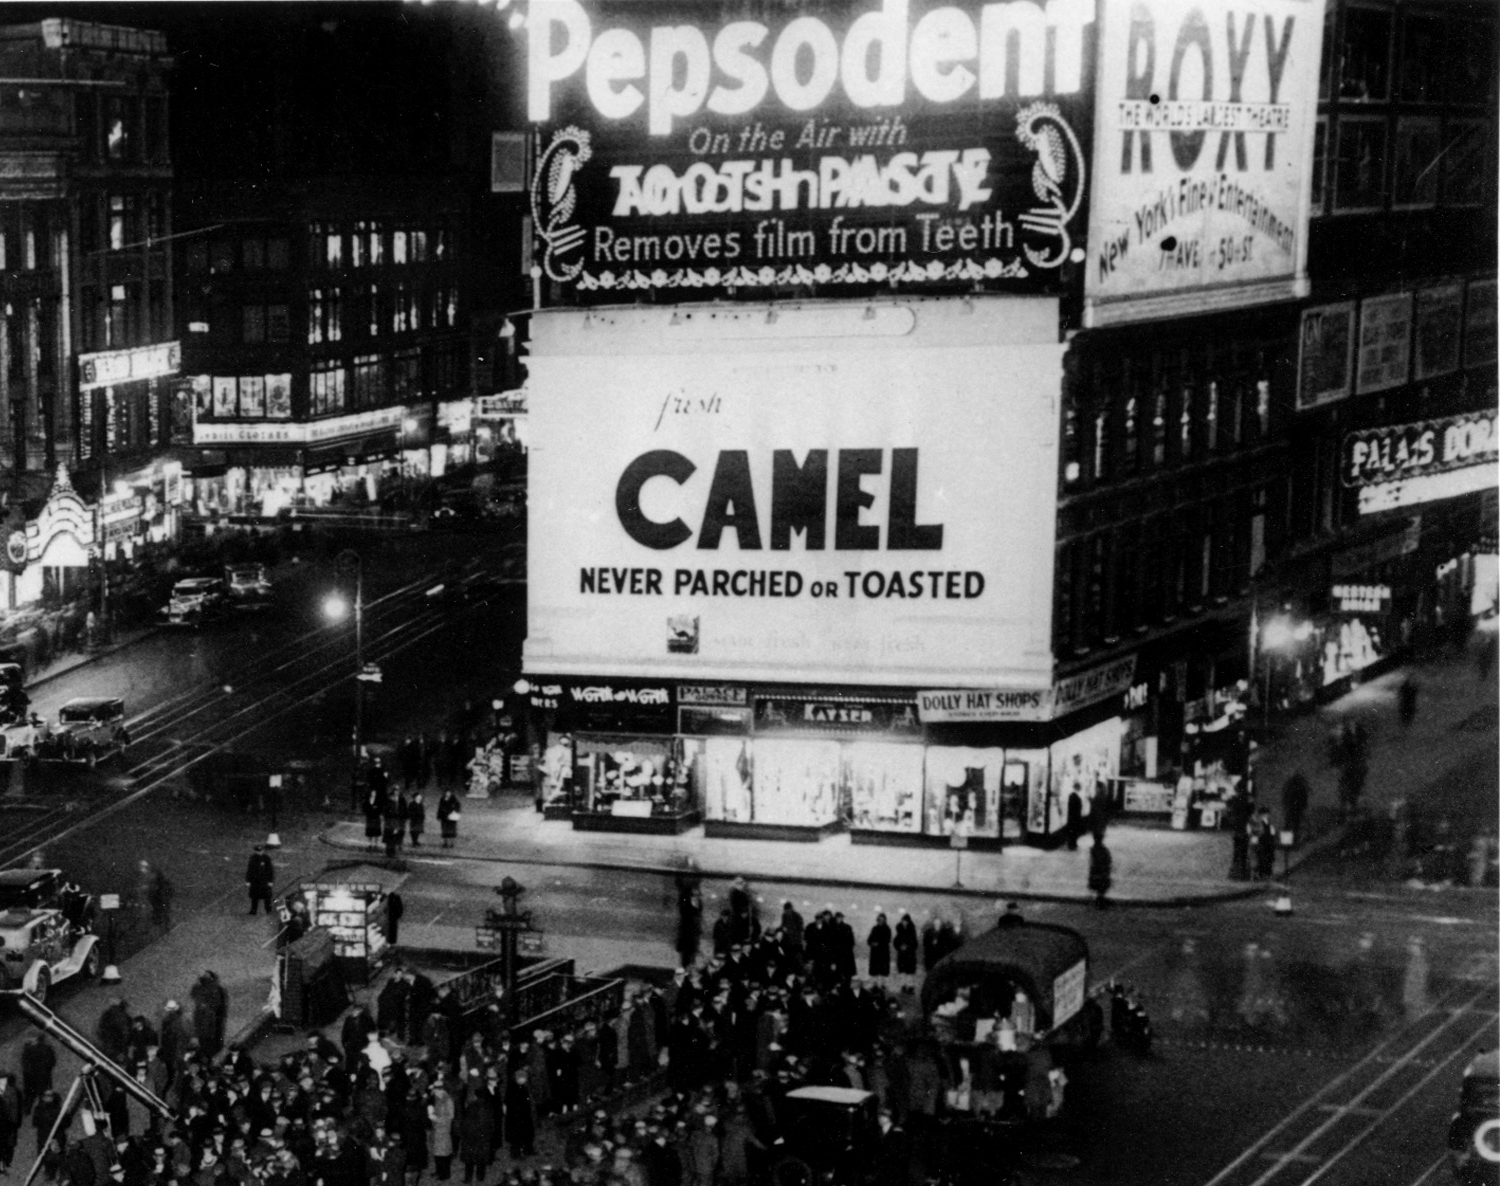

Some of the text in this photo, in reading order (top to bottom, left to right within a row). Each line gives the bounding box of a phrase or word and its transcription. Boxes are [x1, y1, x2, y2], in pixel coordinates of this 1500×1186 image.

[688, 115, 908, 155] On the Air with
[594, 211, 1014, 262] Removes film from Teeth
[1099, 227, 1130, 284] New
[615, 446, 944, 551] CAMEL
[579, 566, 664, 597] NEVER
[673, 569, 802, 599] PARCHED
[845, 569, 986, 601] TOASTED
[922, 691, 1041, 711] DOLLY HAT SHOPS
